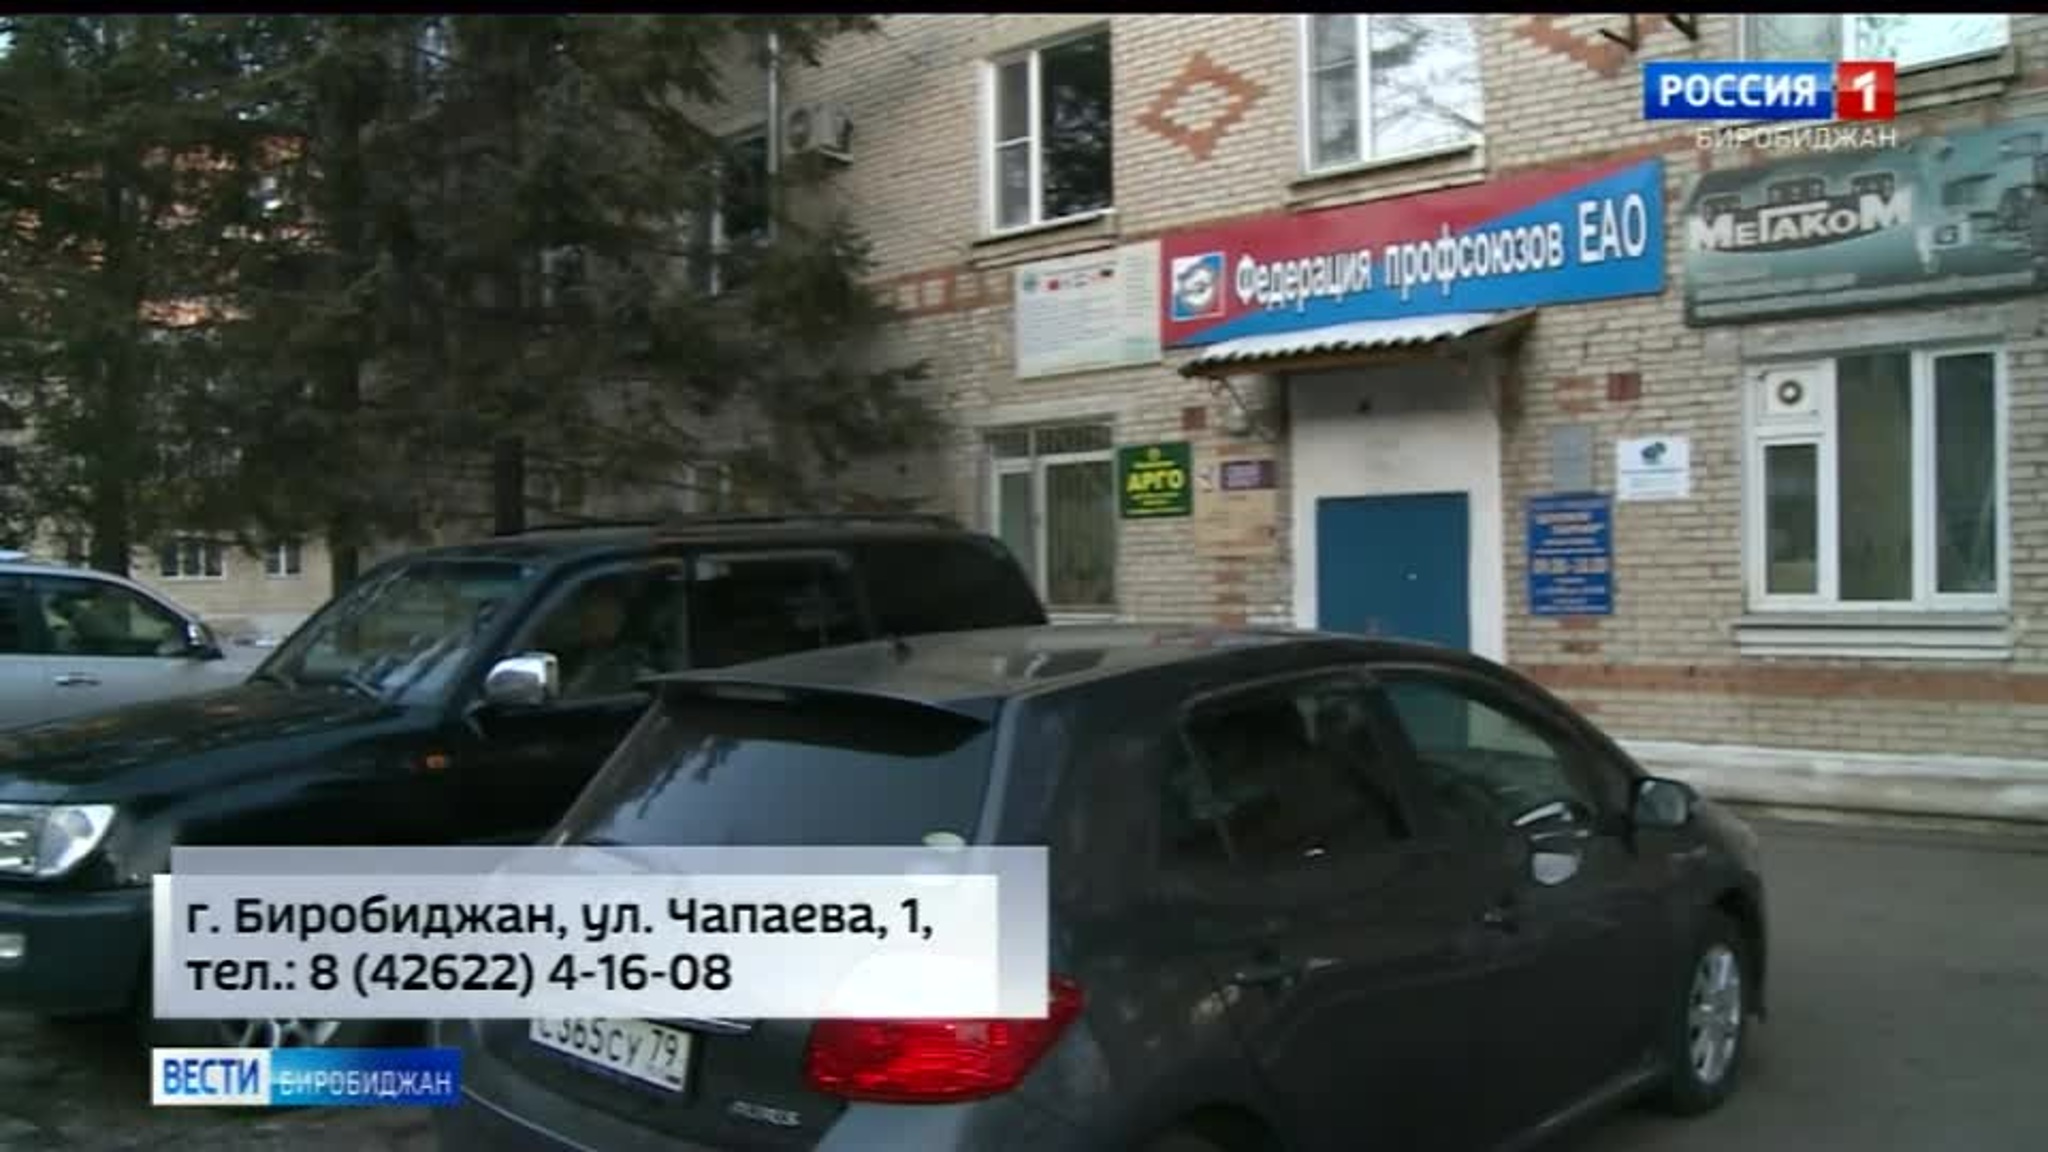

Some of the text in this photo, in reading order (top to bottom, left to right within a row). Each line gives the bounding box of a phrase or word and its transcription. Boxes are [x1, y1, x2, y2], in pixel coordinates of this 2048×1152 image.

[1236, 248, 1373, 311] Федерация
[1384, 223, 1565, 300] профсоюзов
[1576, 194, 1647, 264] ЕАО
[1126, 469, 1185, 492] АРГО
